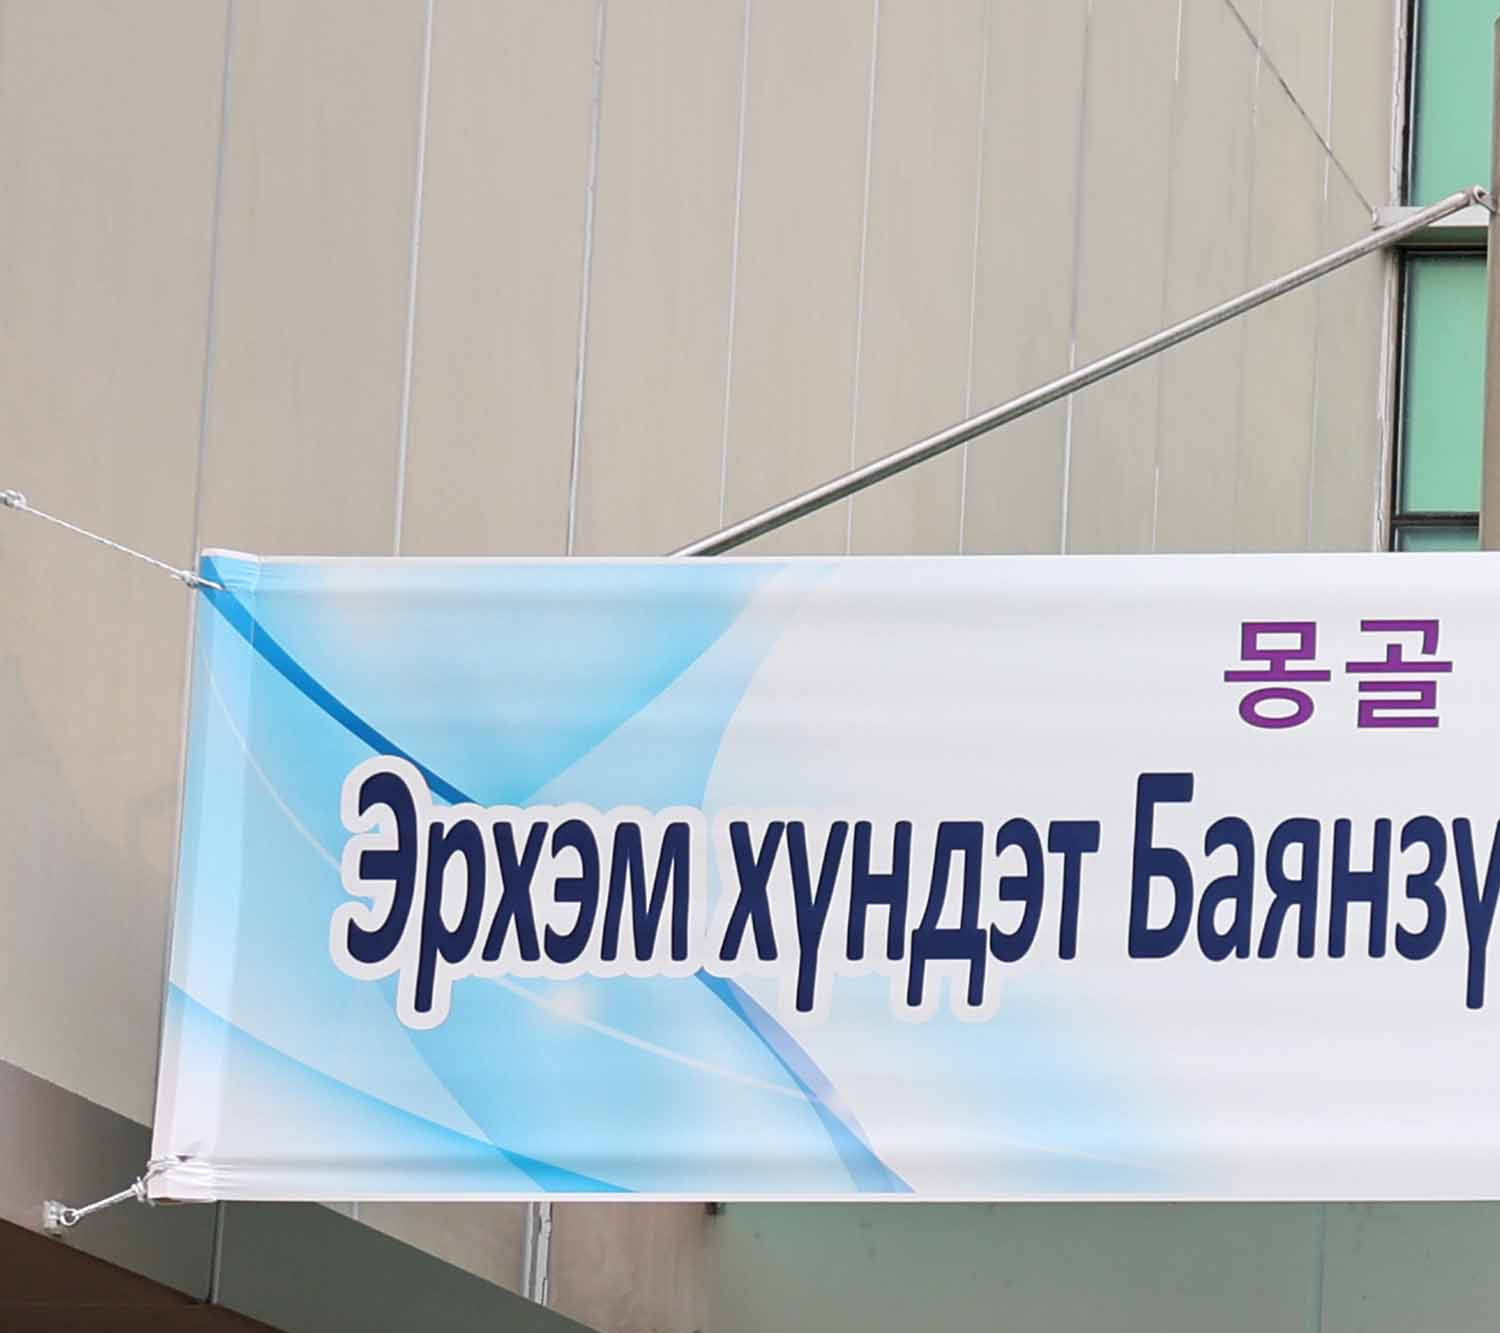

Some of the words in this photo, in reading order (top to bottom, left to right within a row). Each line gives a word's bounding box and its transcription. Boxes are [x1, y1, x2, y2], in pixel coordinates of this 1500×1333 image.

[1226, 620, 1452, 728] 몽골
[347, 771, 690, 1013] Эрхэм
[719, 817, 1100, 1012] хүндэт
